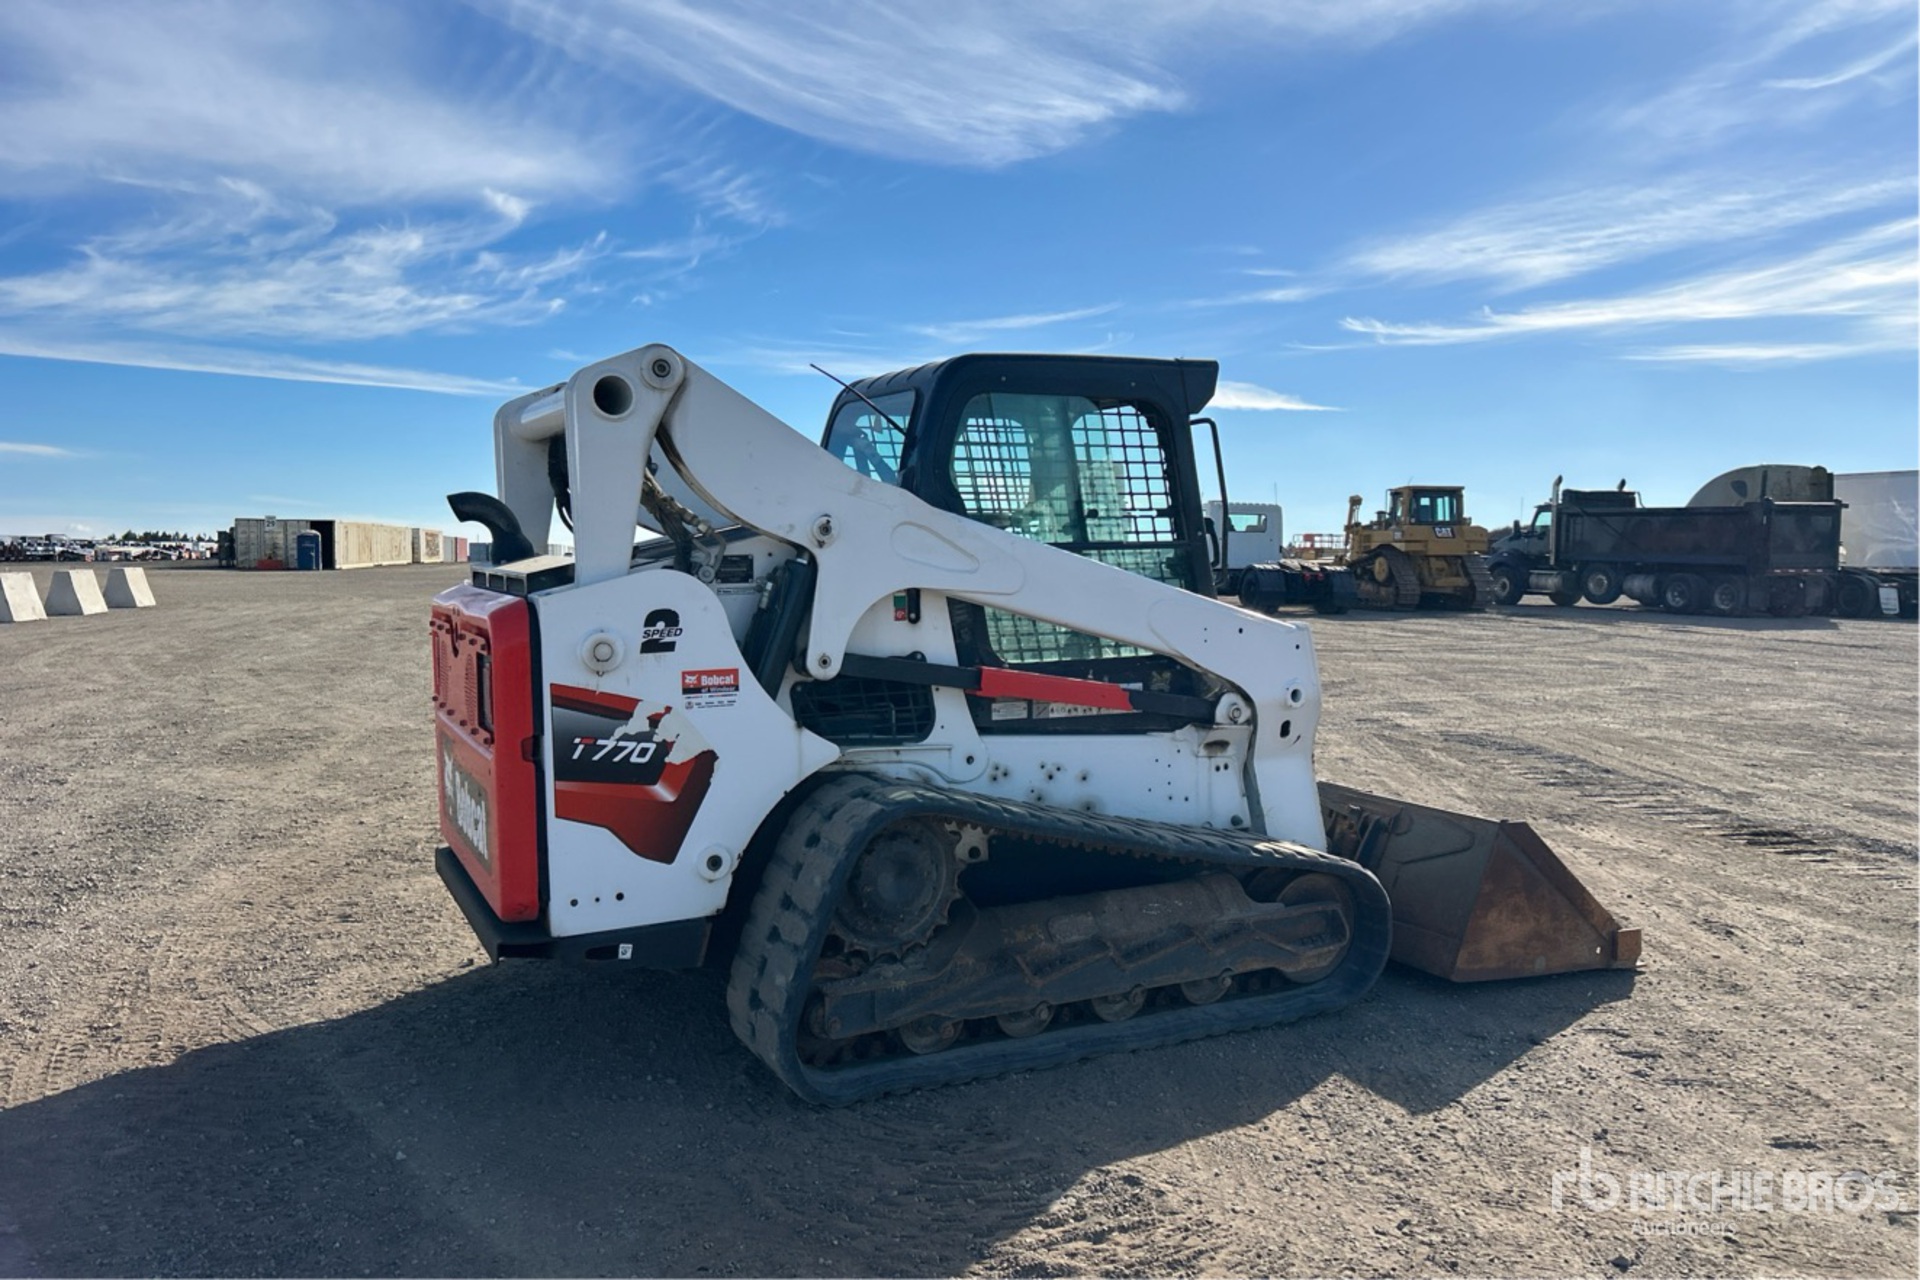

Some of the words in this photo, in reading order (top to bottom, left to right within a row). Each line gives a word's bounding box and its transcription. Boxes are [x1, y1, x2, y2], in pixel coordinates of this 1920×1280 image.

[640, 608, 680, 654] 2
[642, 628, 683, 639] SPEED
[701, 674, 734, 686] Bobcat
[572, 737, 657, 763] T770
